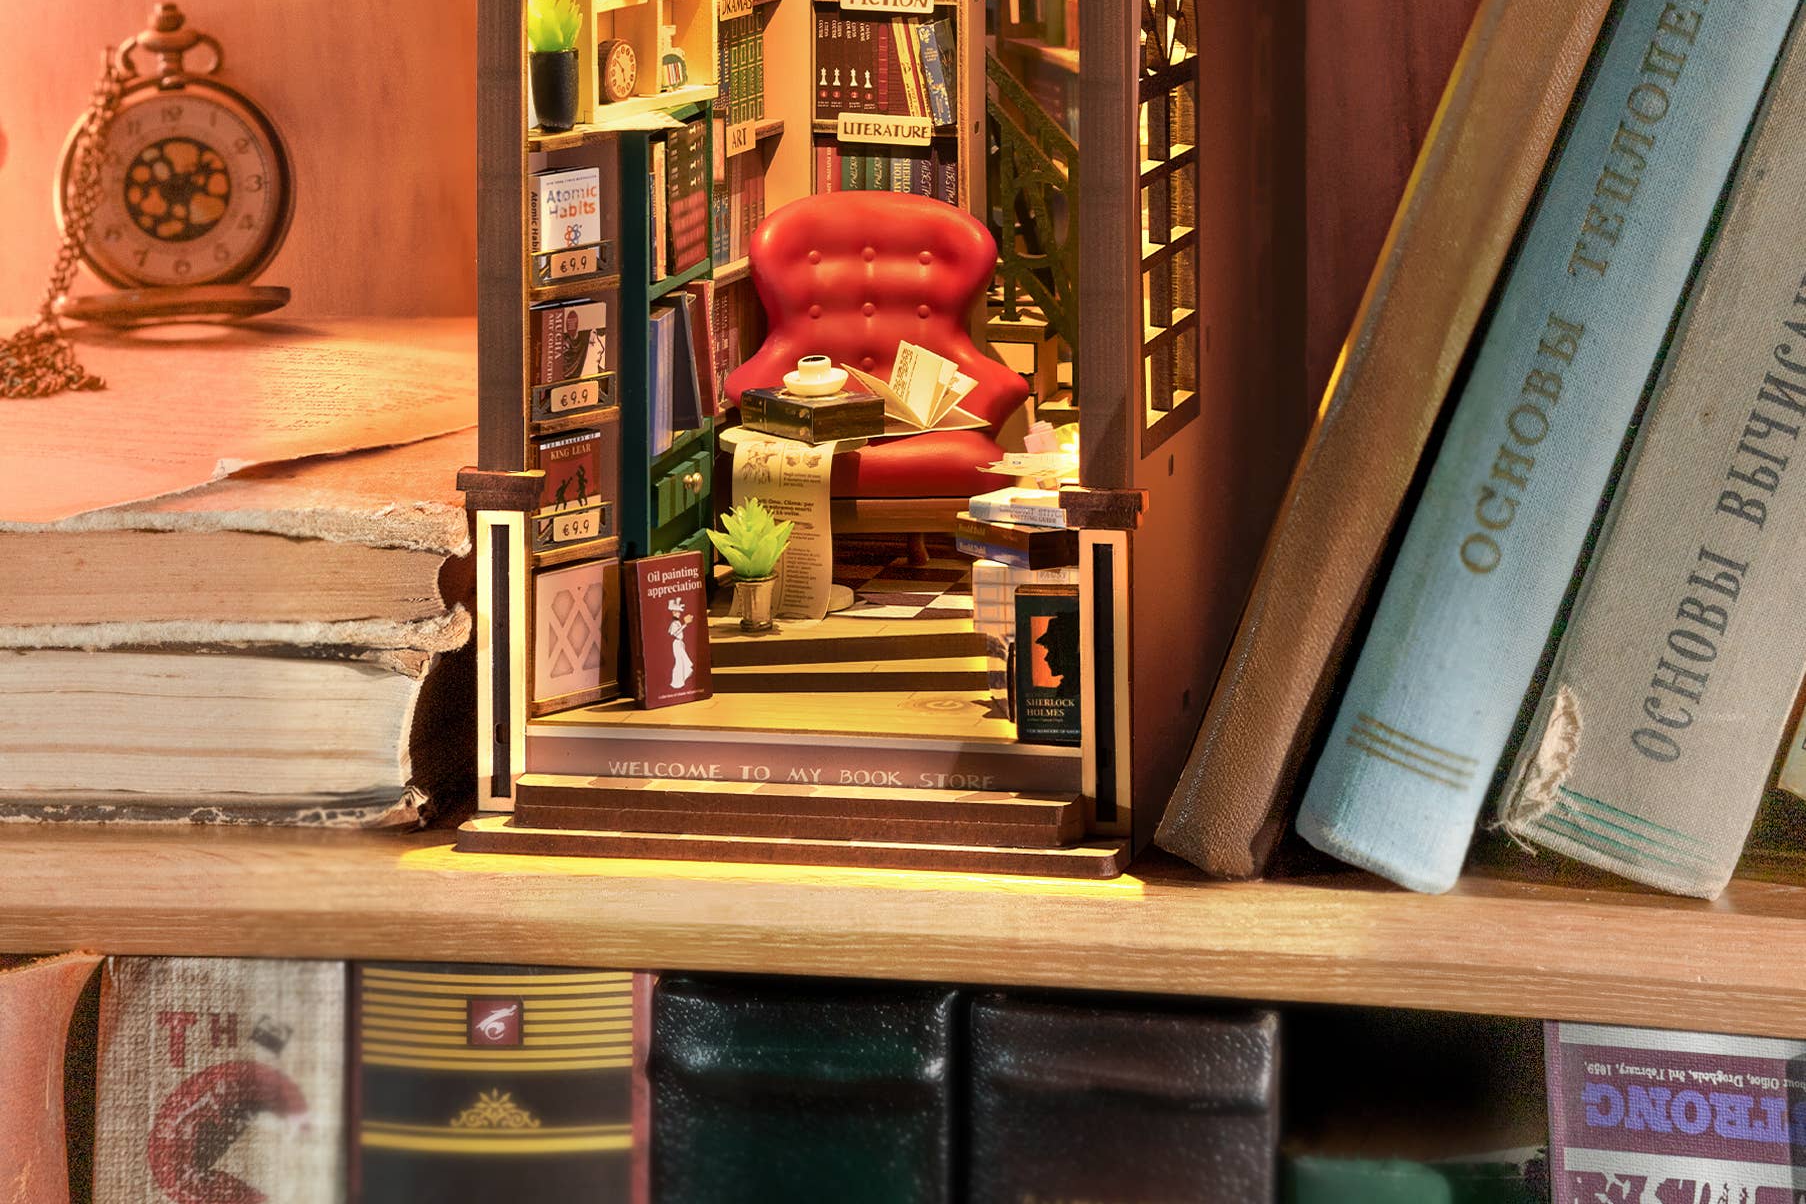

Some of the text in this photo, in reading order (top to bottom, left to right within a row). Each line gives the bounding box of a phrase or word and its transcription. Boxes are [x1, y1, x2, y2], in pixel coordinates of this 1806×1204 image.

[732, 127, 747, 149] ART
[843, 121, 931, 138] LITERATURE
[245, 174, 262, 192] 3
[546, 185, 597, 204] Atomic
[530, 192, 541, 226] Atomic
[549, 200, 596, 220] Habits
[560, 255, 587, 273] €9.9
[555, 312, 564, 360] MUCHA
[560, 389, 588, 407] €9.9
[550, 443, 592, 461] KING LEAR
[1460, 311, 1585, 575] ОСНОВЫ
[563, 519, 590, 536] €9.9
[1630, 274, 1806, 763] ОСНОВЫ ВЫЧИС
[647, 566, 699, 583] Oil painting
[647, 580, 702, 598] appreciation
[1025, 698, 1075, 707] SHERLOCK
[1026, 709, 1065, 717] HOLMES
[608, 760, 997, 791] WELCOME TO MY BOOK STORE
[1616, 1063, 1665, 1081] February,
[1668, 1068, 1686, 1082] 3rd
[1688, 1070, 1744, 1089] Drogheda,
[1749, 1076, 1780, 1090] Office,
